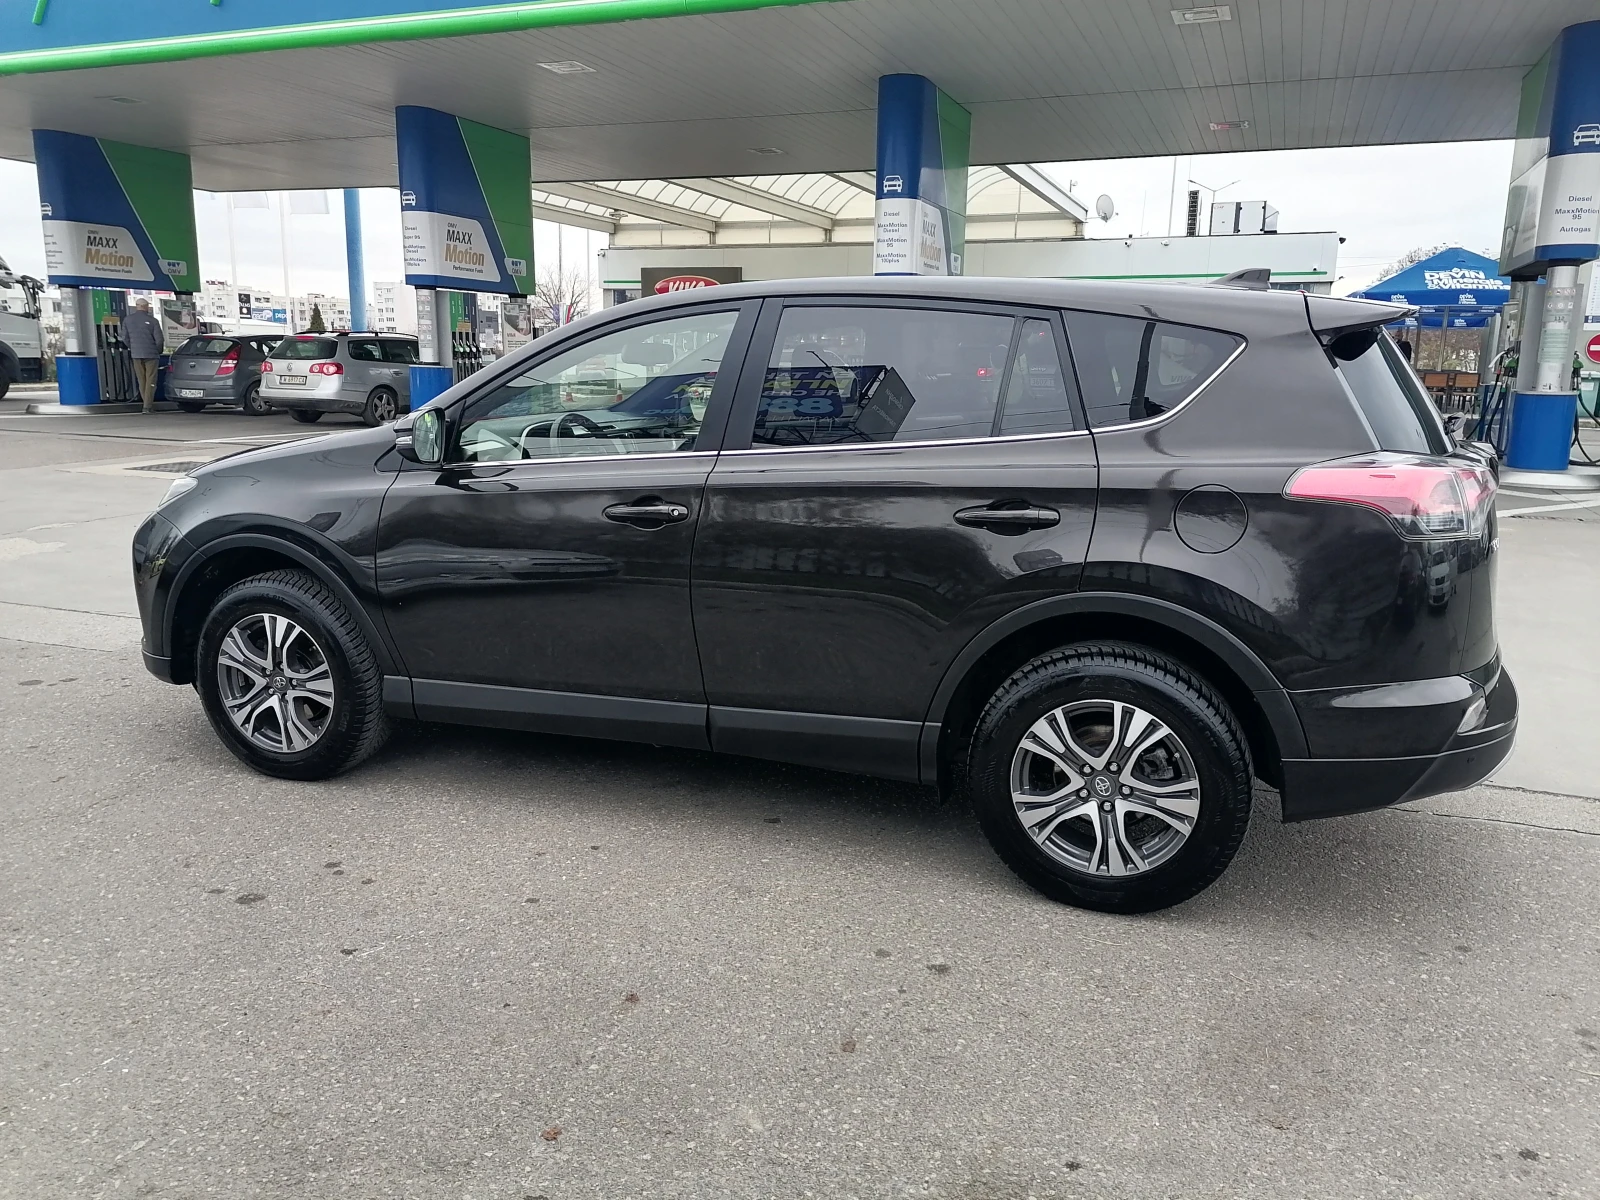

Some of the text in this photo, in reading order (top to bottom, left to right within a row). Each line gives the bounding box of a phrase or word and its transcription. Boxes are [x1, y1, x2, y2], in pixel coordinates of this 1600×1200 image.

[1555, 207, 1600, 215] MaxxMotion
[922, 219, 937, 238] MAXX
[86, 235, 119, 249] MAXX
[446, 229, 473, 245] MAXX
[444, 244, 485, 267] Motion
[920, 236, 942, 263] Motion
[85, 248, 134, 268] Motion
[452, 265, 474, 273] Performance
[511, 267, 522, 275] OMV
[1424, 268, 1486, 280] DEVIN
